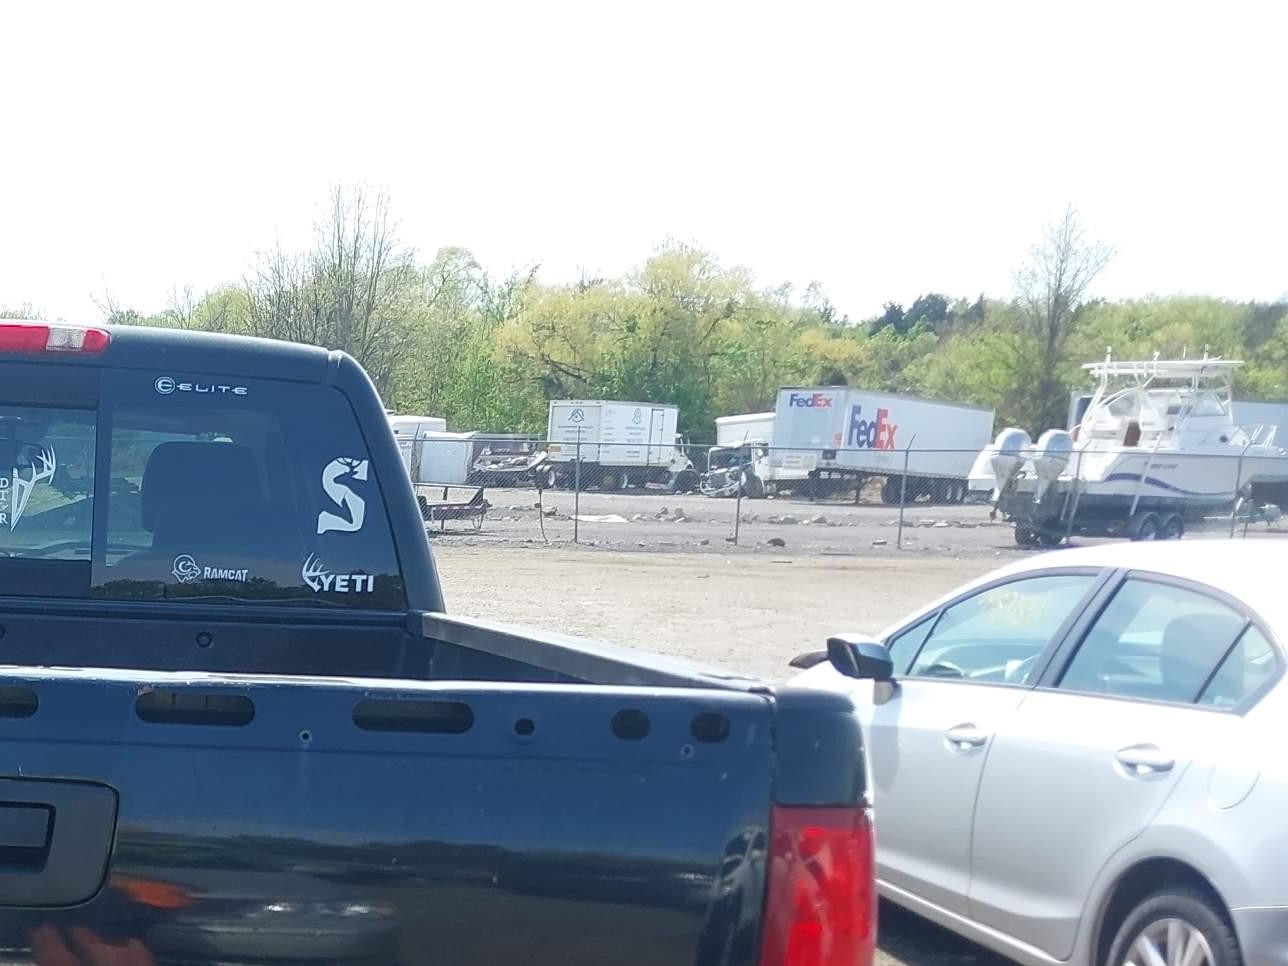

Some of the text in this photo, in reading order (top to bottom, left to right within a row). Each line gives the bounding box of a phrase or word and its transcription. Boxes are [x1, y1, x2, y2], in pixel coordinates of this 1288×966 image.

[176, 383, 248, 395] ELITE
[789, 393, 833, 407] FedEx
[847, 404, 898, 449] FedEx
[203, 566, 249, 583] RAMCAT
[320, 574, 374, 593] YETI
